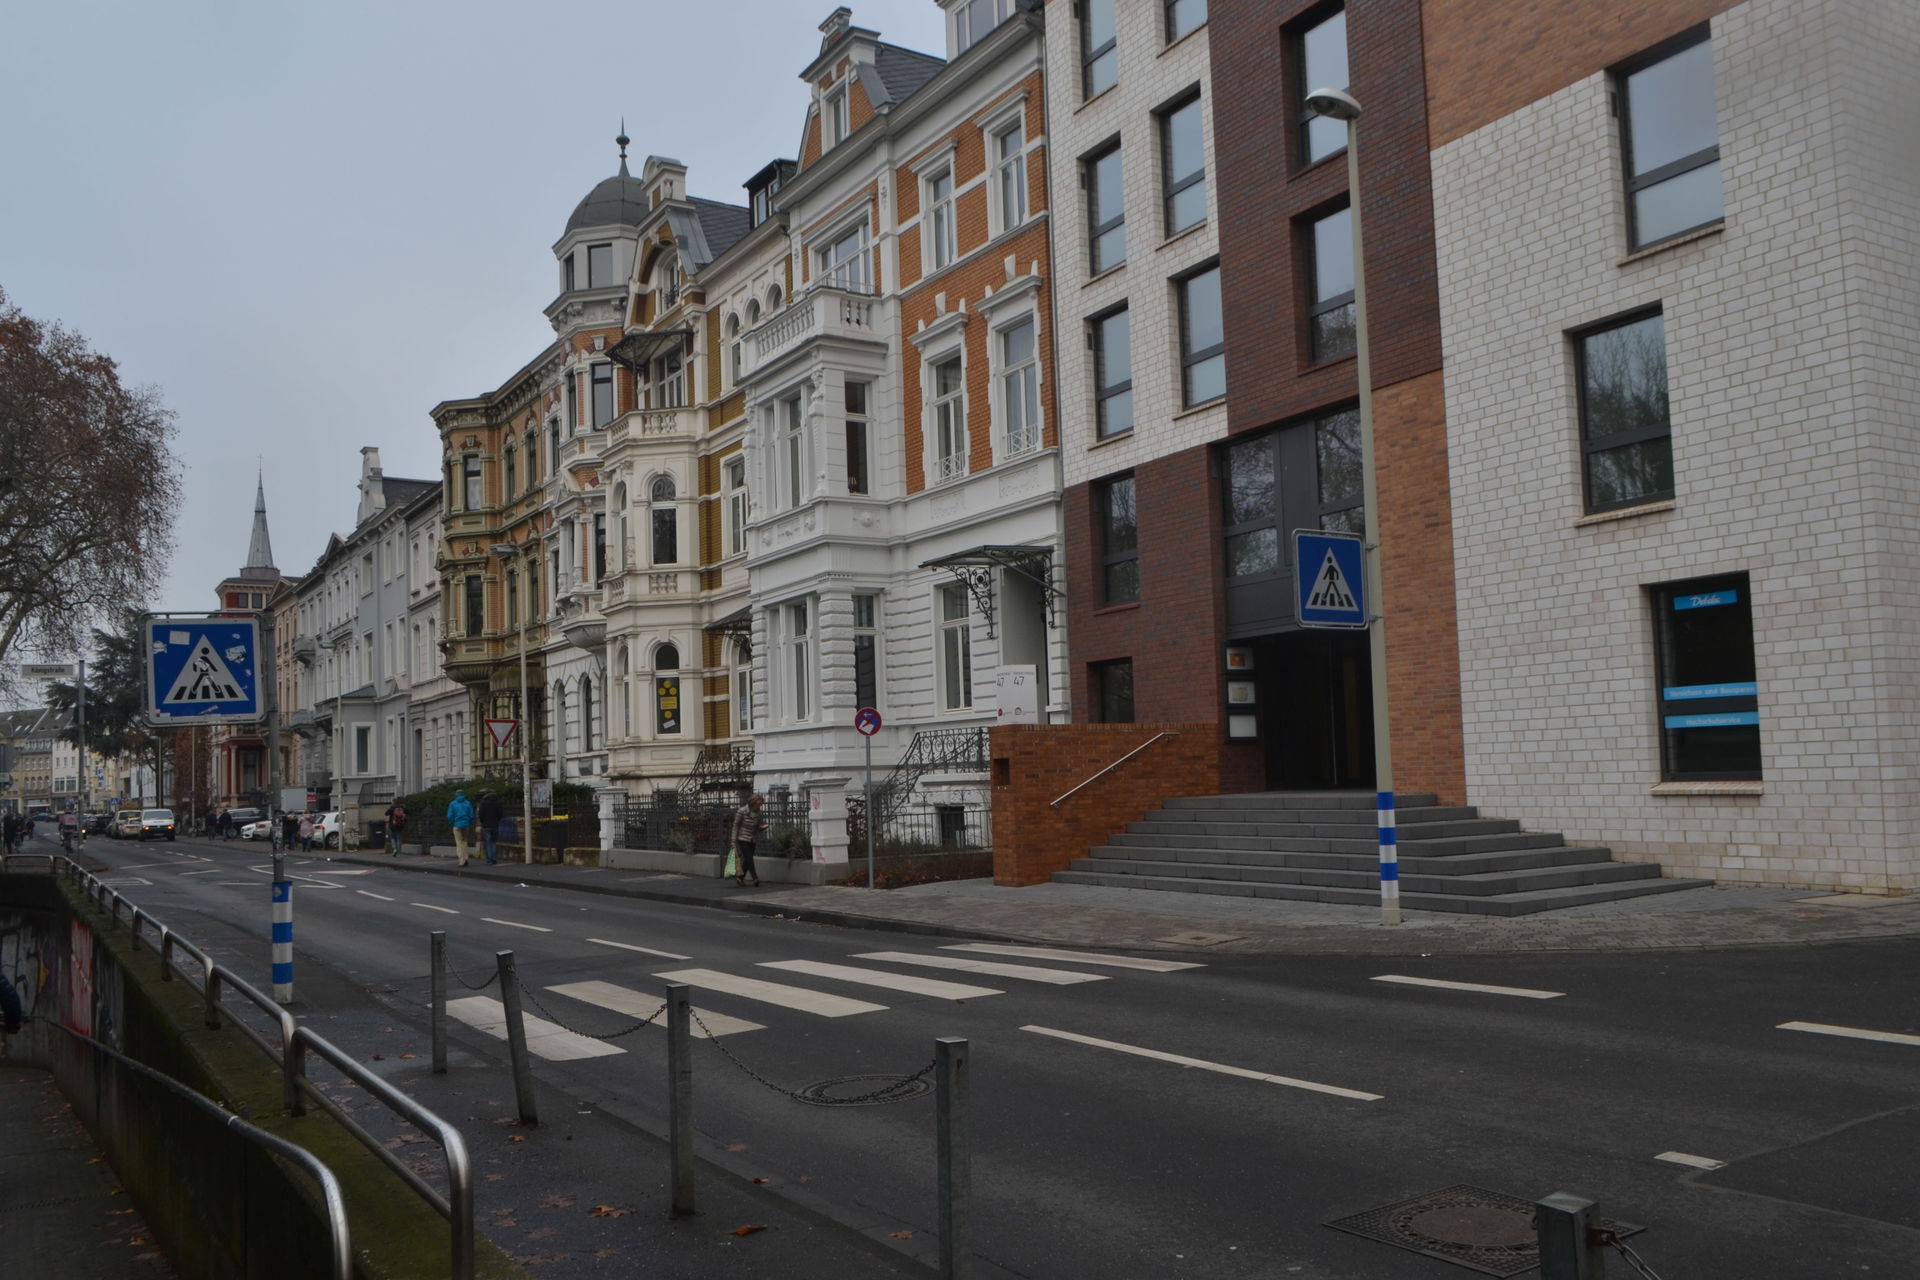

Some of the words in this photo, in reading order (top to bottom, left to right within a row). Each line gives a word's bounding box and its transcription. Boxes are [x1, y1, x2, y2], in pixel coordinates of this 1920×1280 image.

[997, 677, 1004, 686] 47
[1013, 676, 1025, 686] 47
[1704, 687, 1718, 695] und
